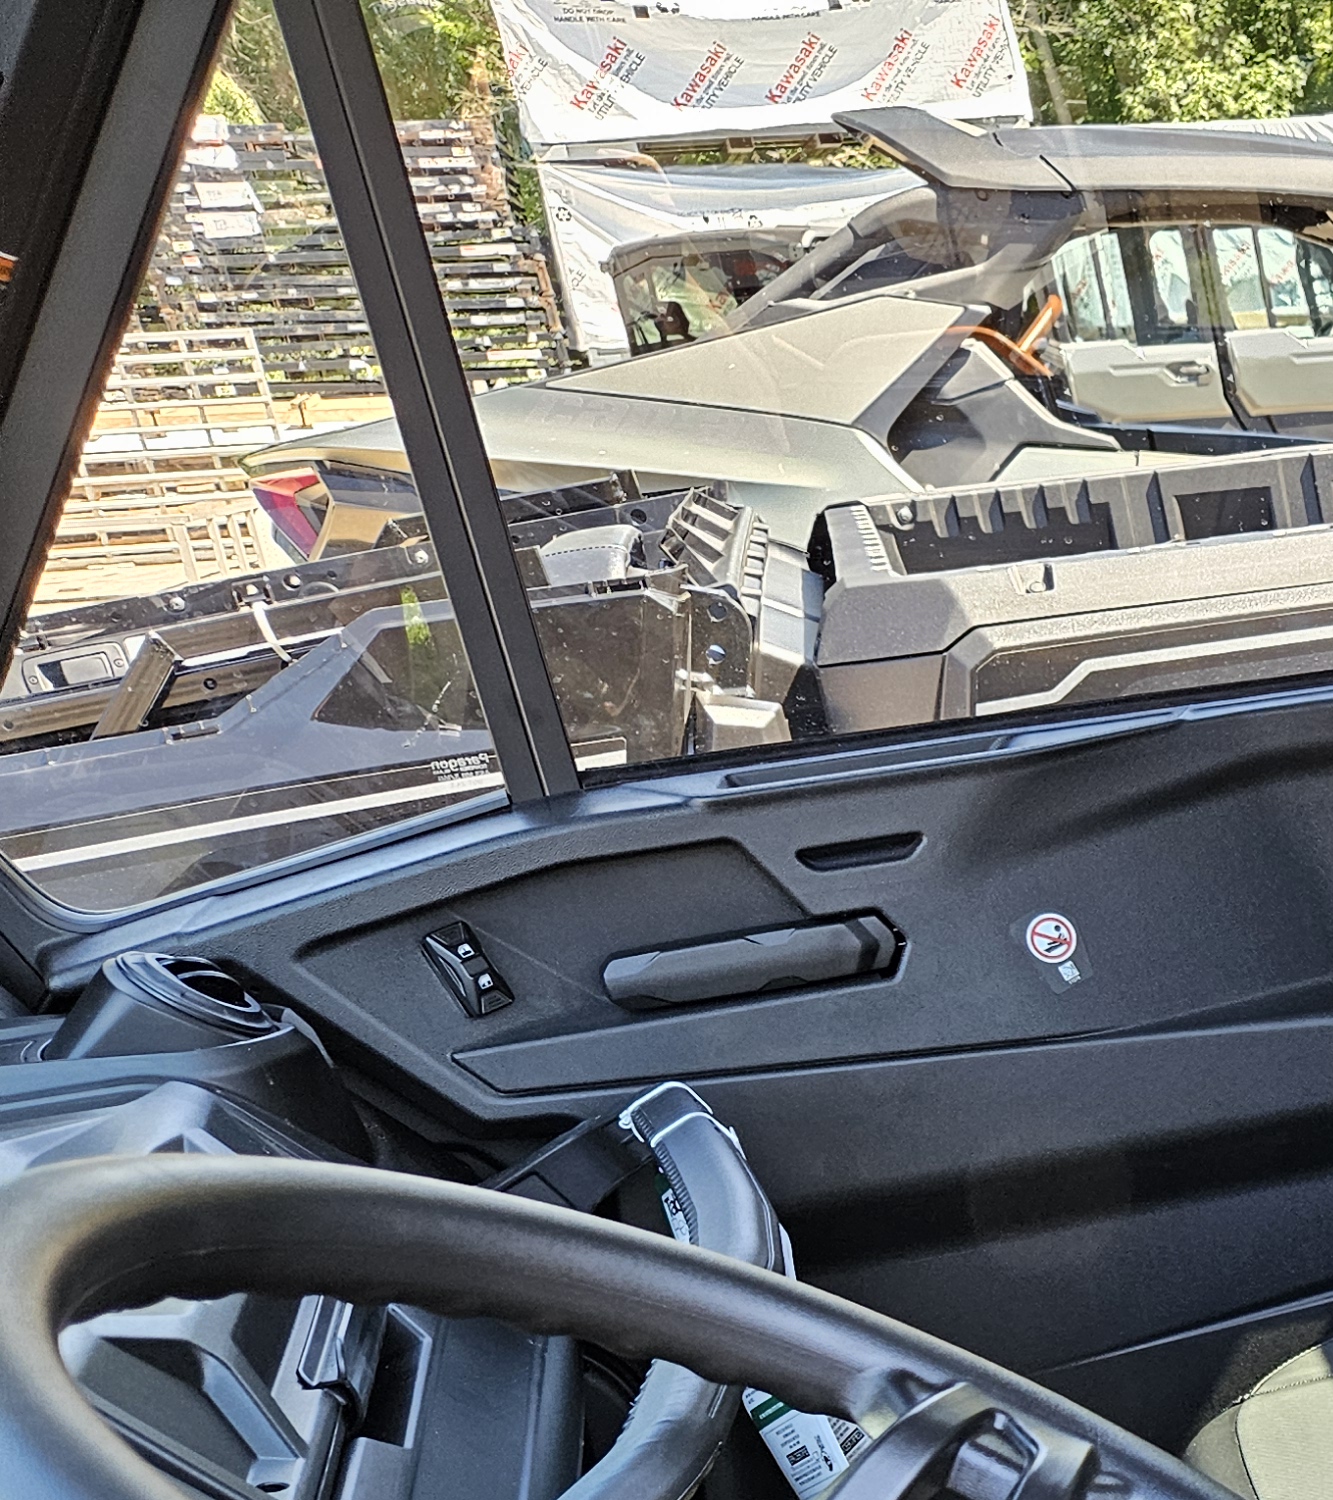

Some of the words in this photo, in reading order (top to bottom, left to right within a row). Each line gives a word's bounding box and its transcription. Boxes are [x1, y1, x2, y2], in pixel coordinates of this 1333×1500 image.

[671, 40, 727, 112] Kawasaki
[764, 31, 821, 104] Kawasaki
[810, 45, 838, 82] VEHICLE
[861, 27, 913, 102] Kawasaki
[950, 13, 1001, 89] Kawasaki
